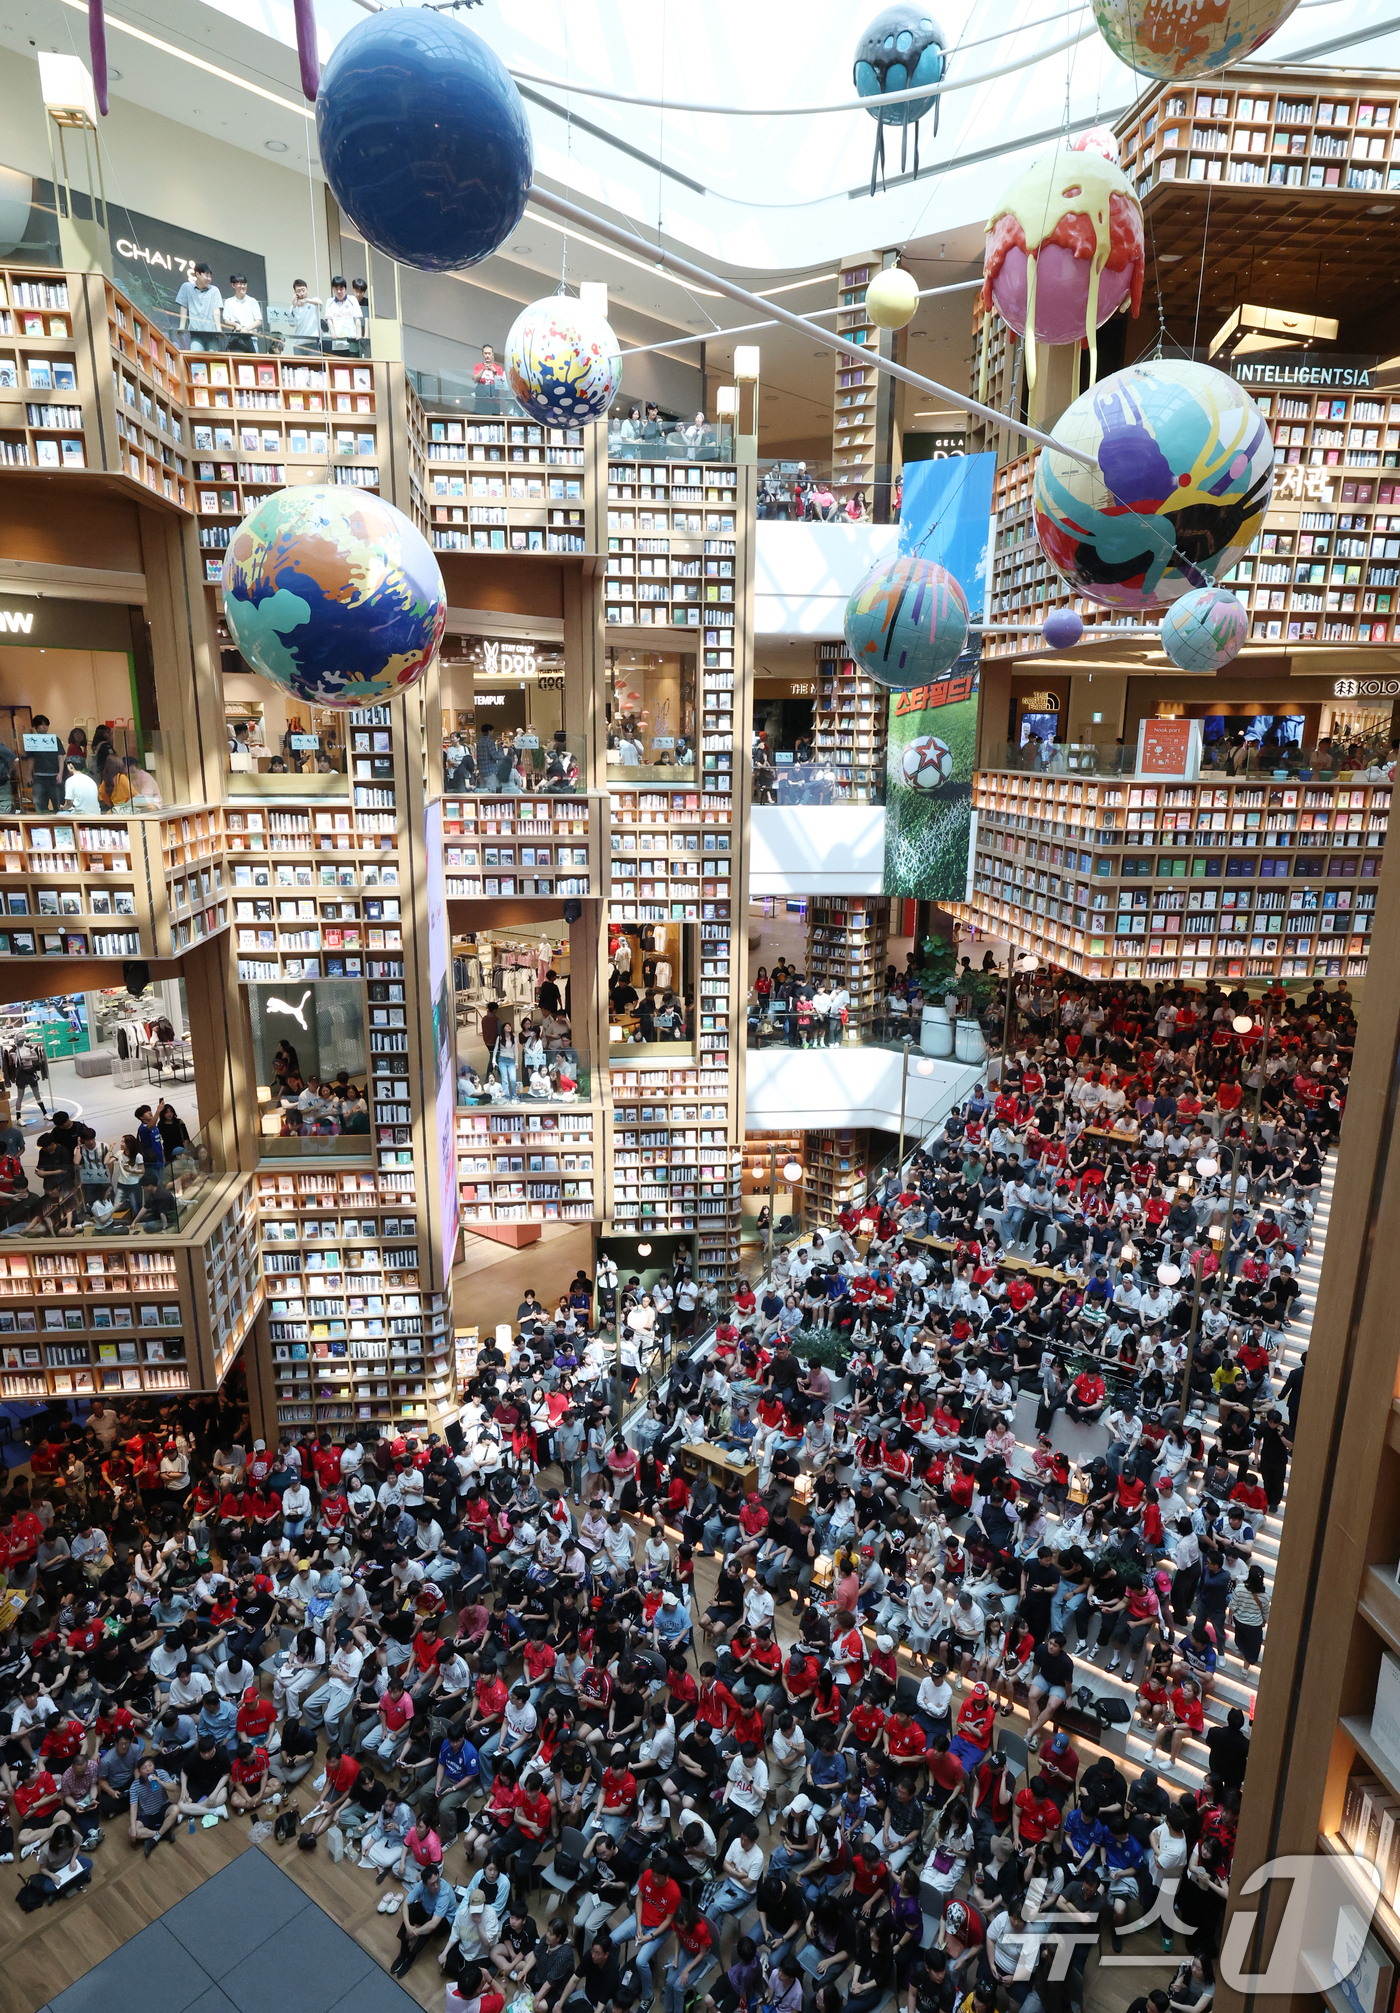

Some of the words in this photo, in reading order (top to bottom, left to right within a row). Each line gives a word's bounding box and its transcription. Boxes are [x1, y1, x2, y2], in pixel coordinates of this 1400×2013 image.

[1236, 364, 1370, 386] INTELLIGENTSIA
[501, 644, 515, 652] STAY
[516, 645, 535, 654] CRAZY
[790, 683, 808, 694] THE
[1357, 680, 1400, 695] KOLO
[474, 695, 505, 705] TEMPUR
[895, 676, 972, 717] 스타필드!
[833, 1414, 847, 1423] LIVE
[736, 1779, 752, 1793] AIA
